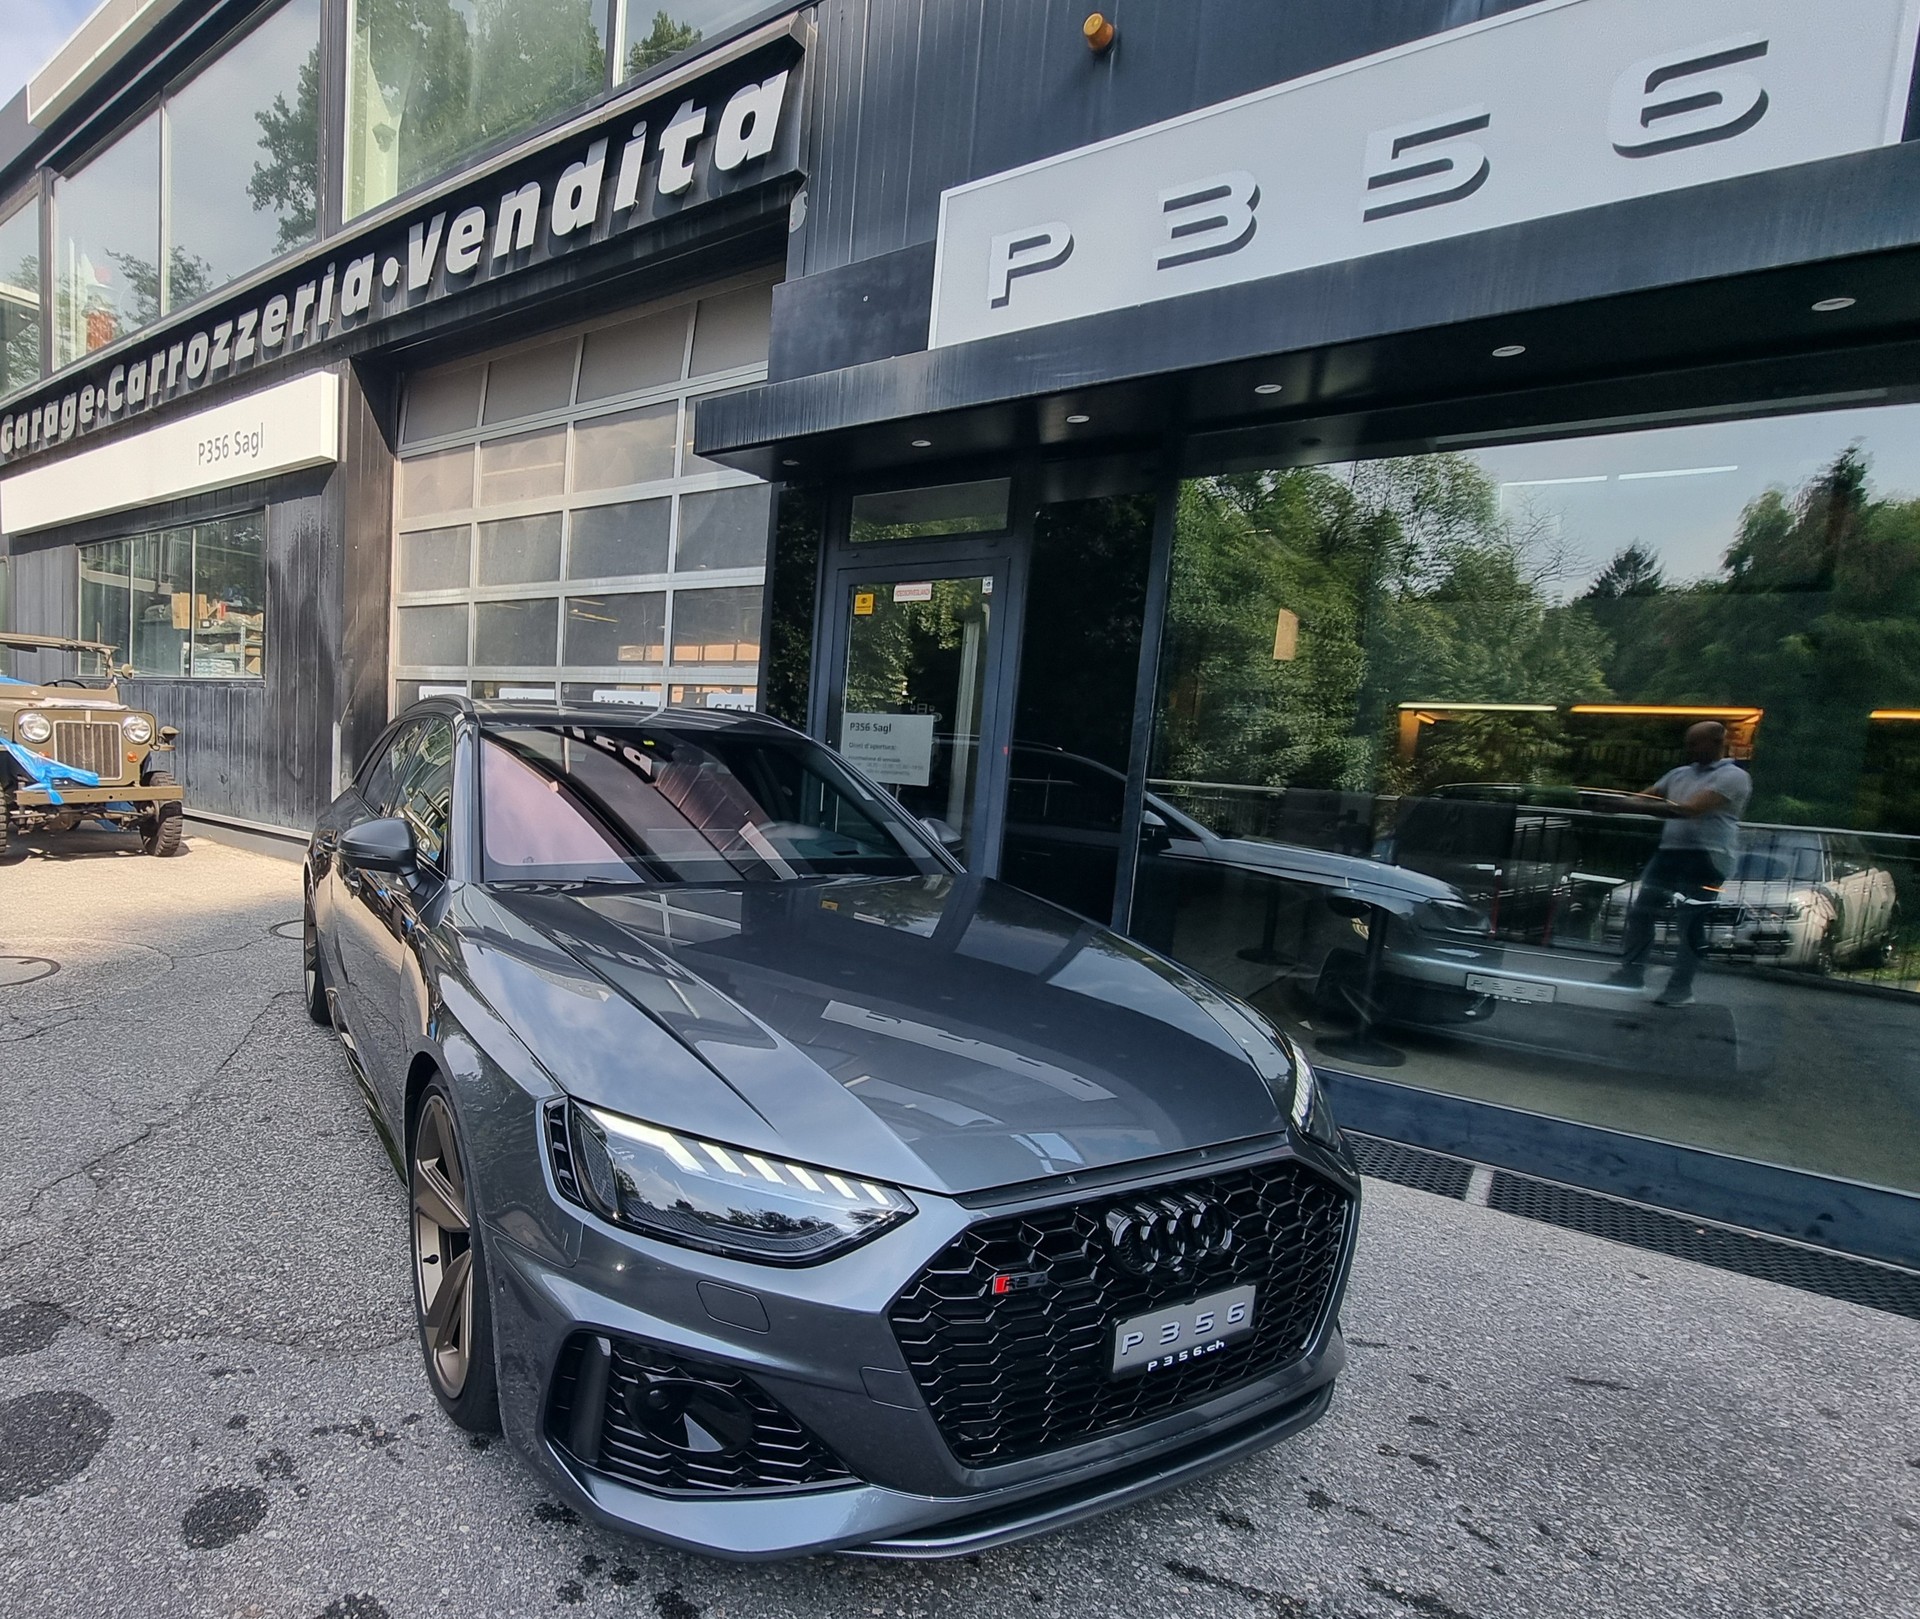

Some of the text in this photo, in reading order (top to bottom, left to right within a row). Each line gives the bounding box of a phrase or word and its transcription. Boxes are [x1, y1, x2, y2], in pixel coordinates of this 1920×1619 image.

[1, 69, 789, 454] Garage Carrozzeria Vendita
[198, 421, 264, 466] P356 Sagl
[849, 722, 892, 734] P356 Sagl
[1147, 1340, 1225, 1372] P356.ch
